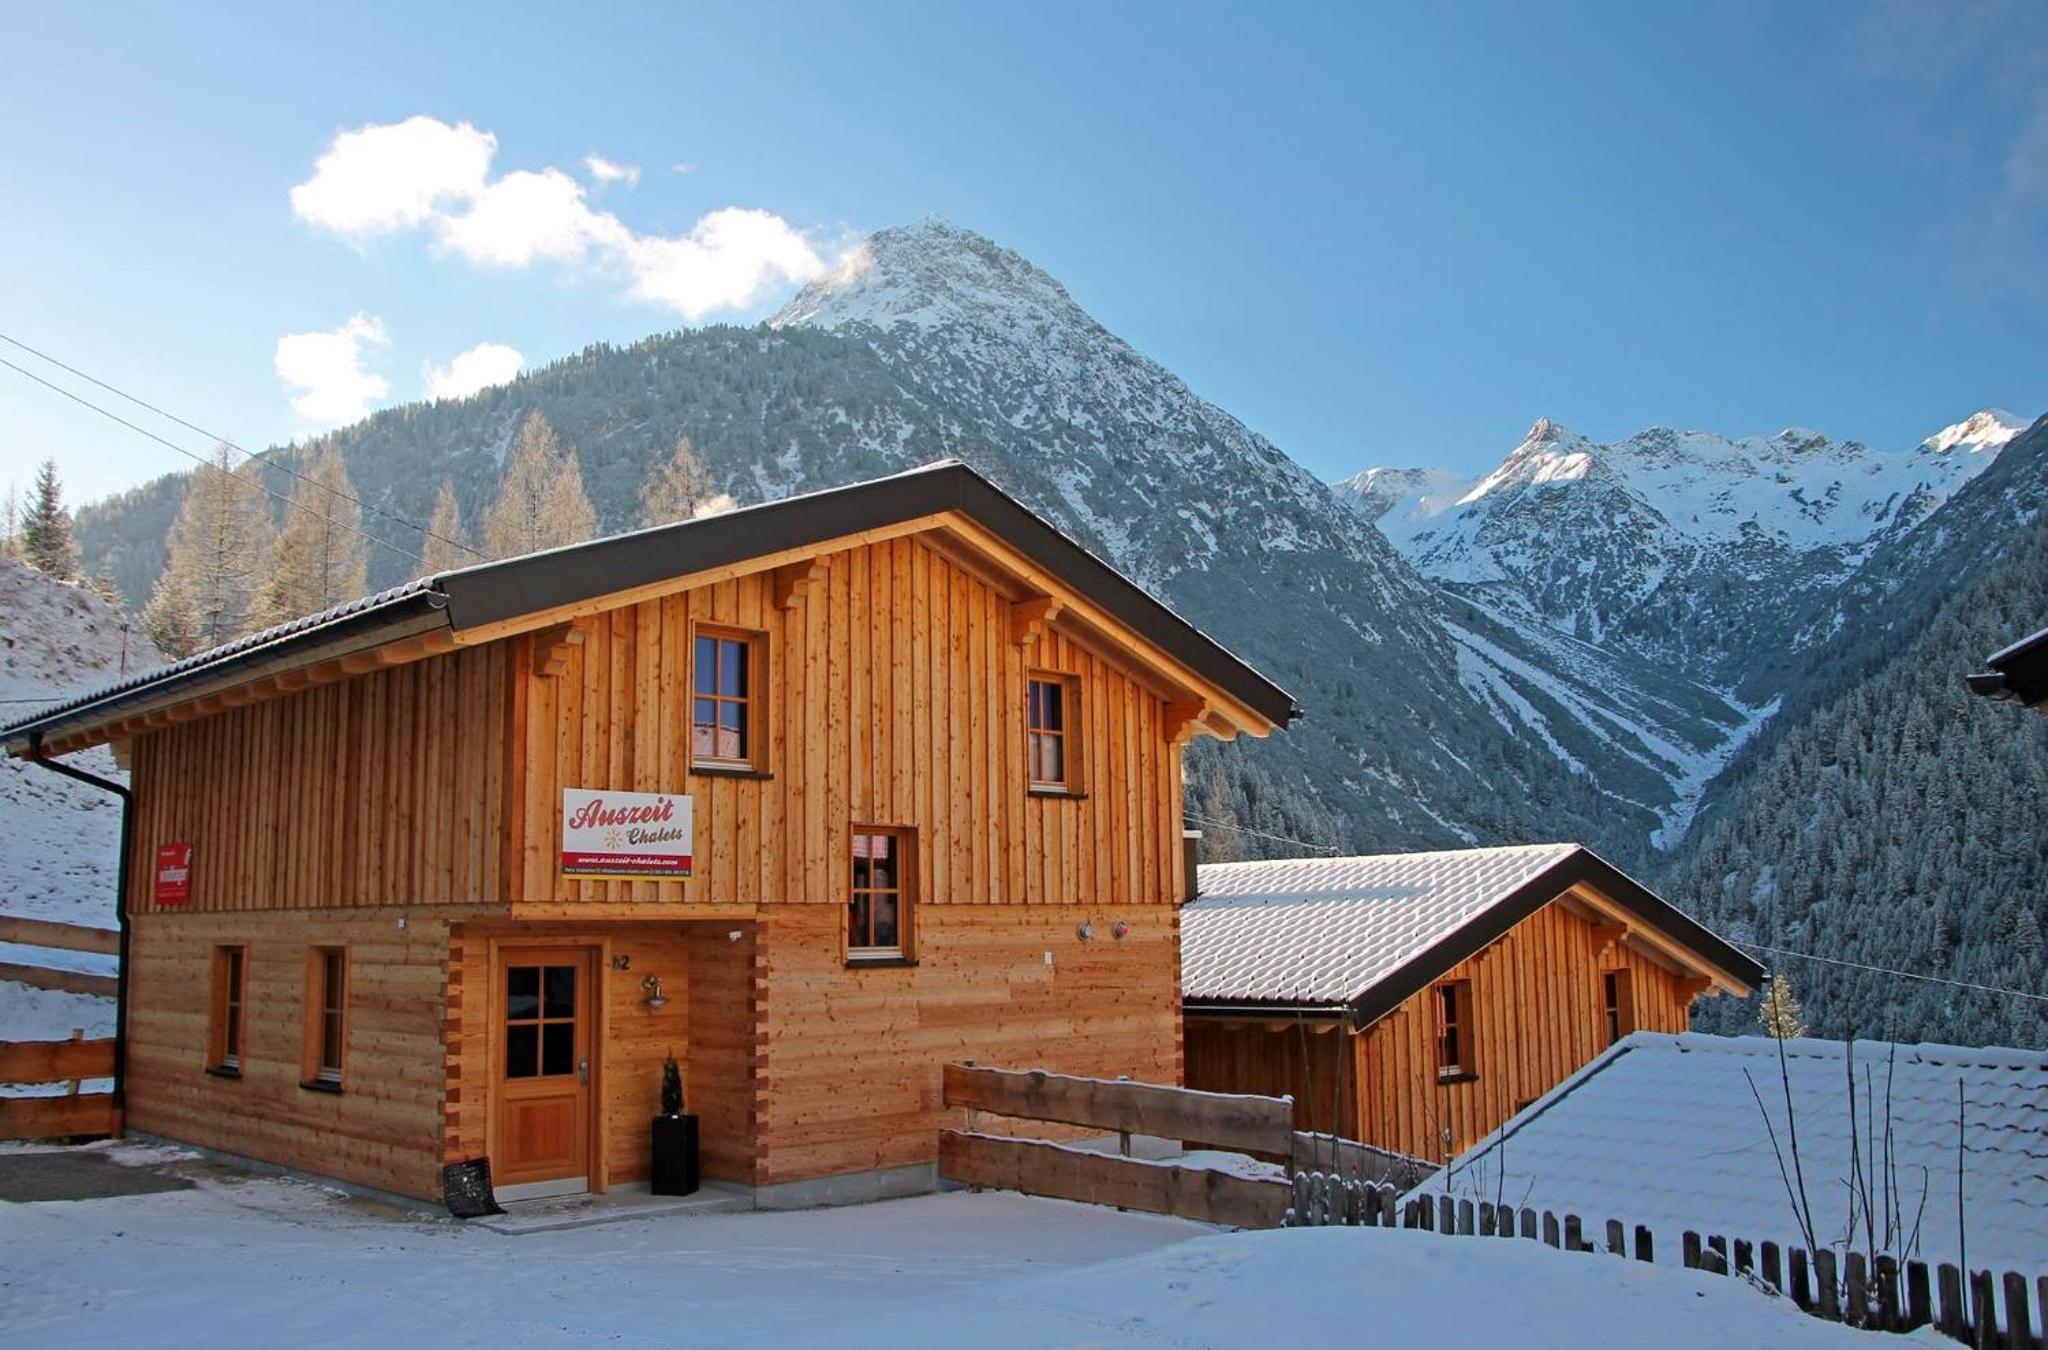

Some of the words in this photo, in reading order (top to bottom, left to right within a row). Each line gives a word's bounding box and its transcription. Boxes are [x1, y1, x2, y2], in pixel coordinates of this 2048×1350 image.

[569, 797, 673, 829] Auszeit
[627, 827, 683, 845] Chalets
[578, 856, 678, 866] www.auszeit-chalets.com
